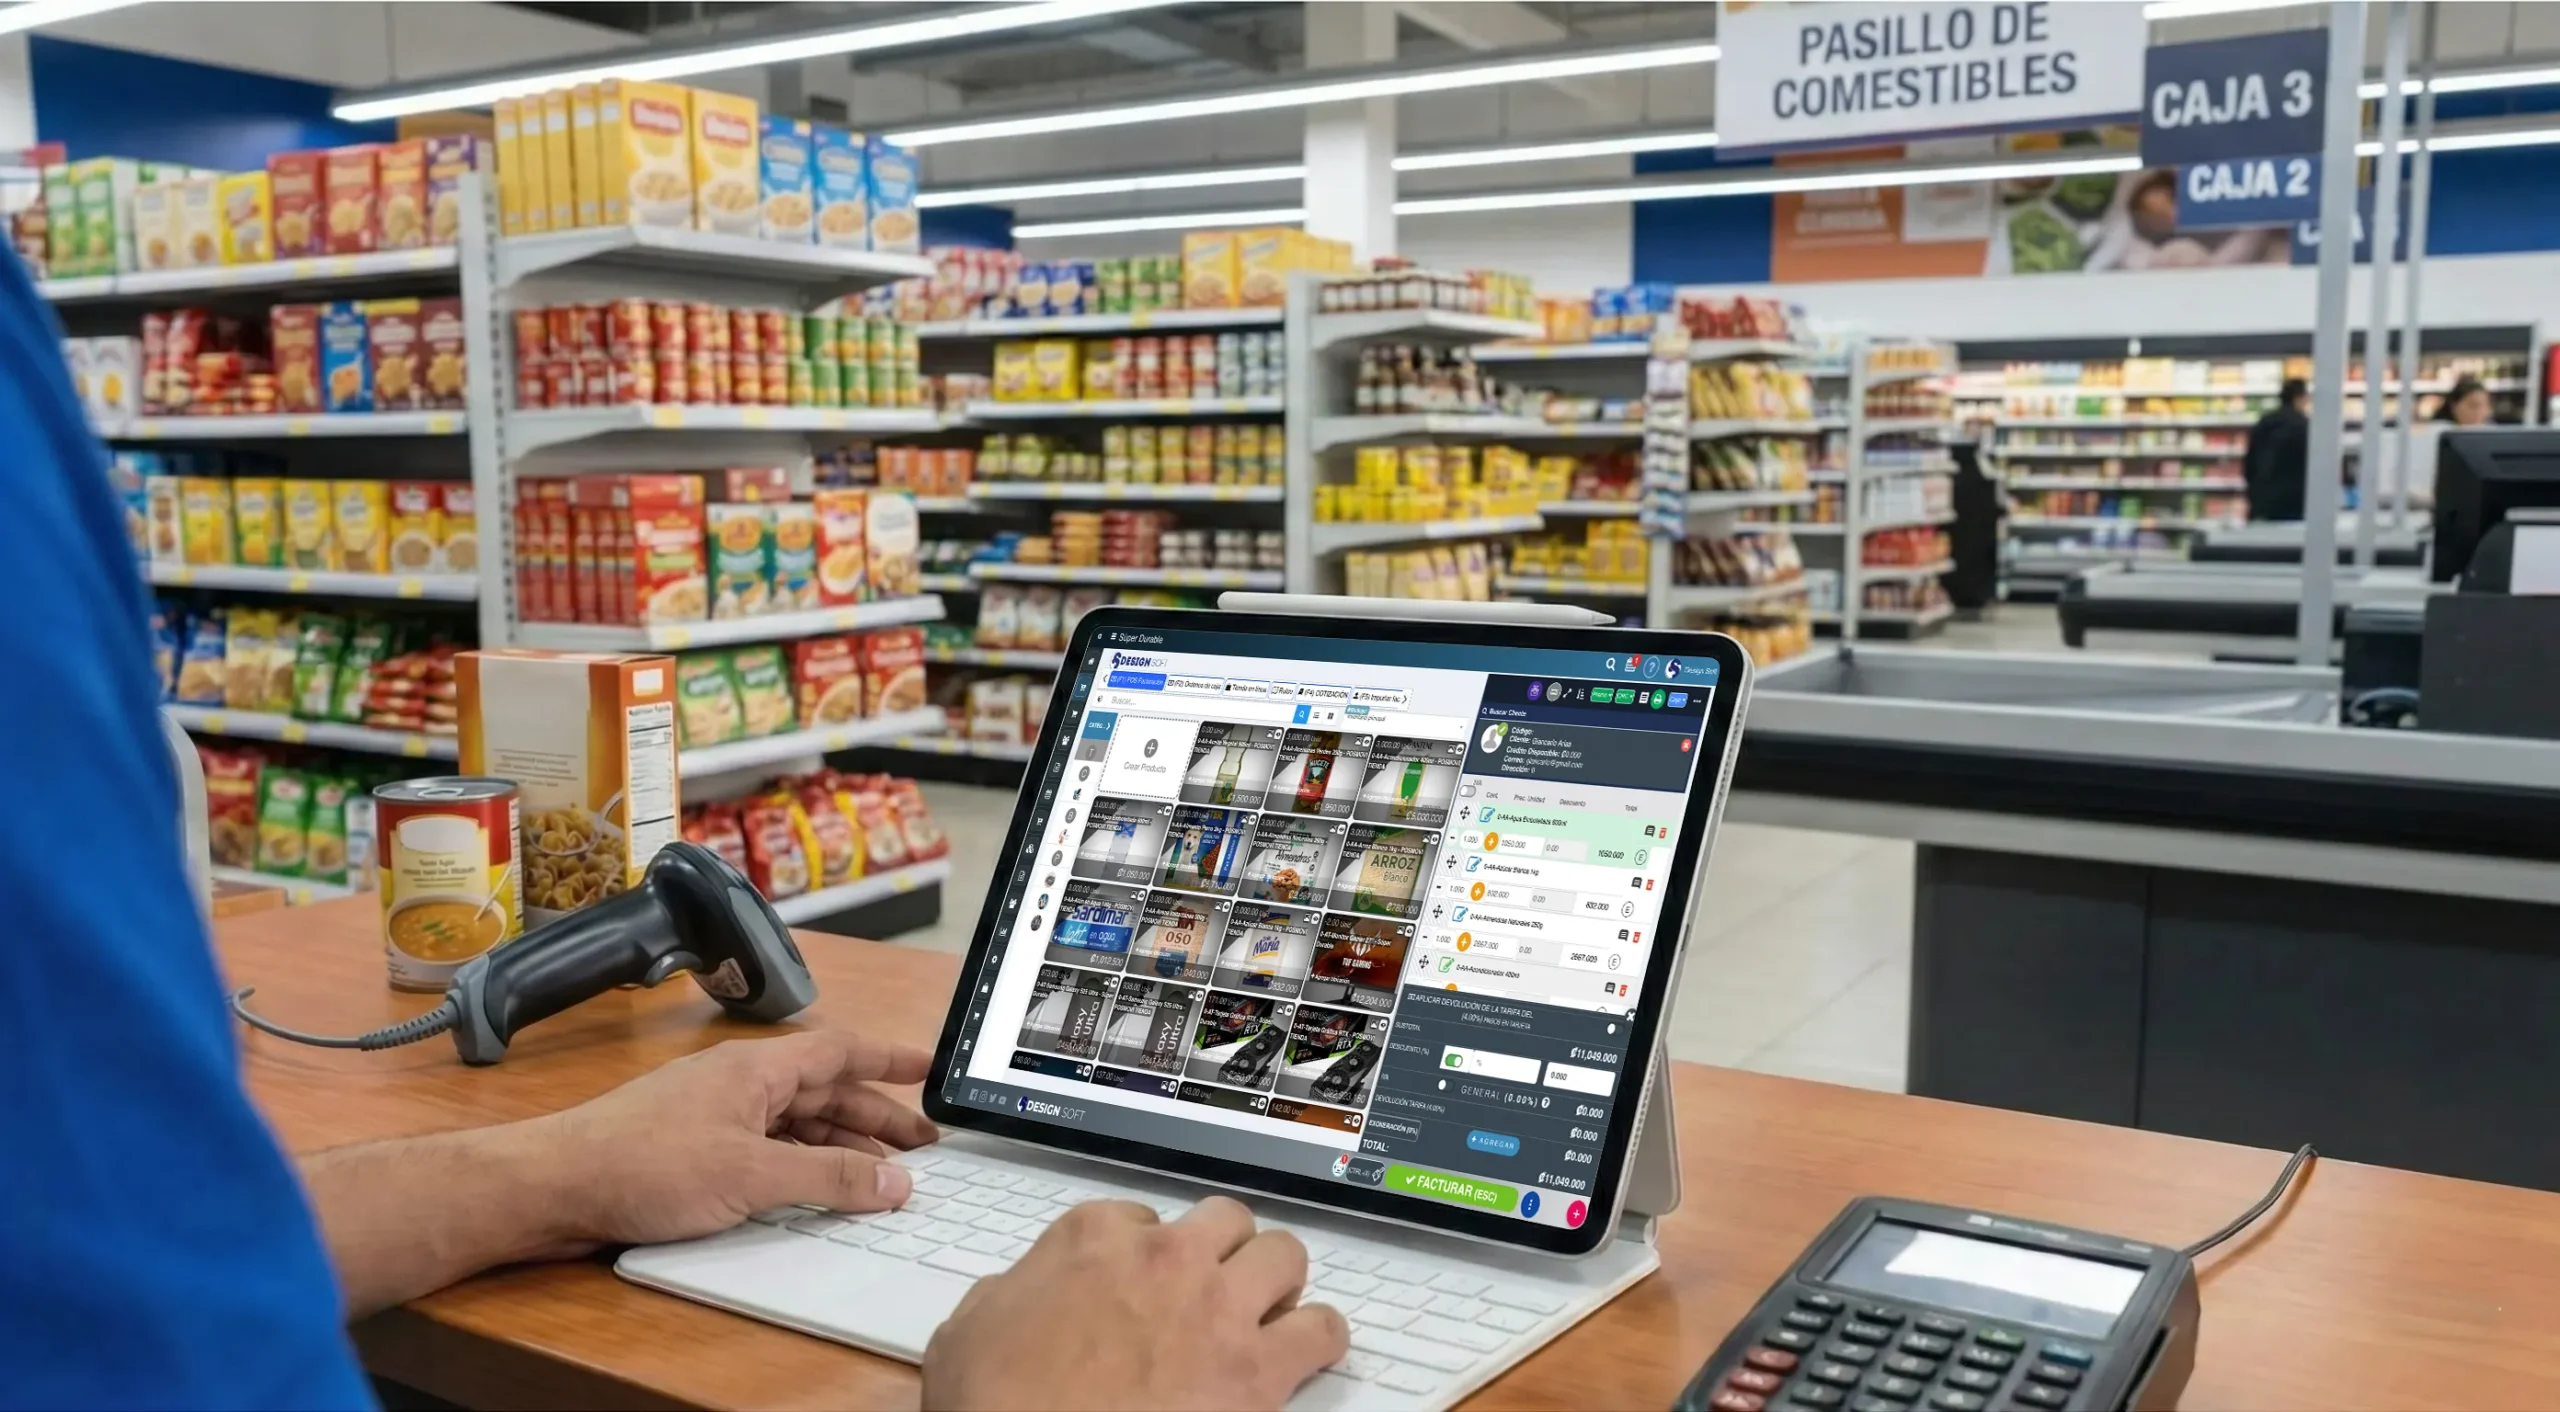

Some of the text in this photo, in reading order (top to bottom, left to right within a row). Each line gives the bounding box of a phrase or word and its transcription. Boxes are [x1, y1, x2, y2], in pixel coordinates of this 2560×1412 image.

[1799, 1, 2050, 66] PASILLO DE
[1772, 51, 2078, 120] COMESTIBLES
[2152, 69, 2313, 129] CAJA 3
[2187, 158, 2312, 202] CAJA 2
[1117, 633, 1164, 644] Súper Durable
[1120, 655, 1168, 667] DESIGN SOFT
[1232, 684, 1248, 692] Tienda
[1511, 725, 1534, 736] Código:
[1508, 735, 1531, 744] Cliente:
[1557, 739, 1571, 747] Arias
[1123, 761, 1166, 773] Crear Producto
[1624, 804, 1638, 812] Total
[1274, 849, 1311, 865] Almendras
[1370, 853, 1415, 871] ARROZ
[1382, 871, 1409, 883] Blanco
[1165, 930, 1191, 945] OSO
[1252, 938, 1280, 958] María
[1243, 1021, 1260, 1037] RTX
[1335, 1037, 1353, 1053] RTX
[1570, 1047, 1617, 1065] ₡11,049.000
[1460, 1085, 1538, 1108] GENERAL (0.00%)
[1026, 1100, 1085, 1121] DESIGN SOFT
[1576, 1104, 1603, 1118] ₡0.000
[1368, 1117, 1407, 1132] EXONERACIÓN
[1479, 1136, 1514, 1149] AGREGAR
[1570, 1127, 1598, 1142] ₡0.000
[1361, 1139, 1390, 1152] TOTAL:
[1564, 1149, 1592, 1165] ₡0.000
[1416, 1175, 1497, 1203] FACTURAR (ESC)
[1538, 1171, 1586, 1191] ₡11,049.000
